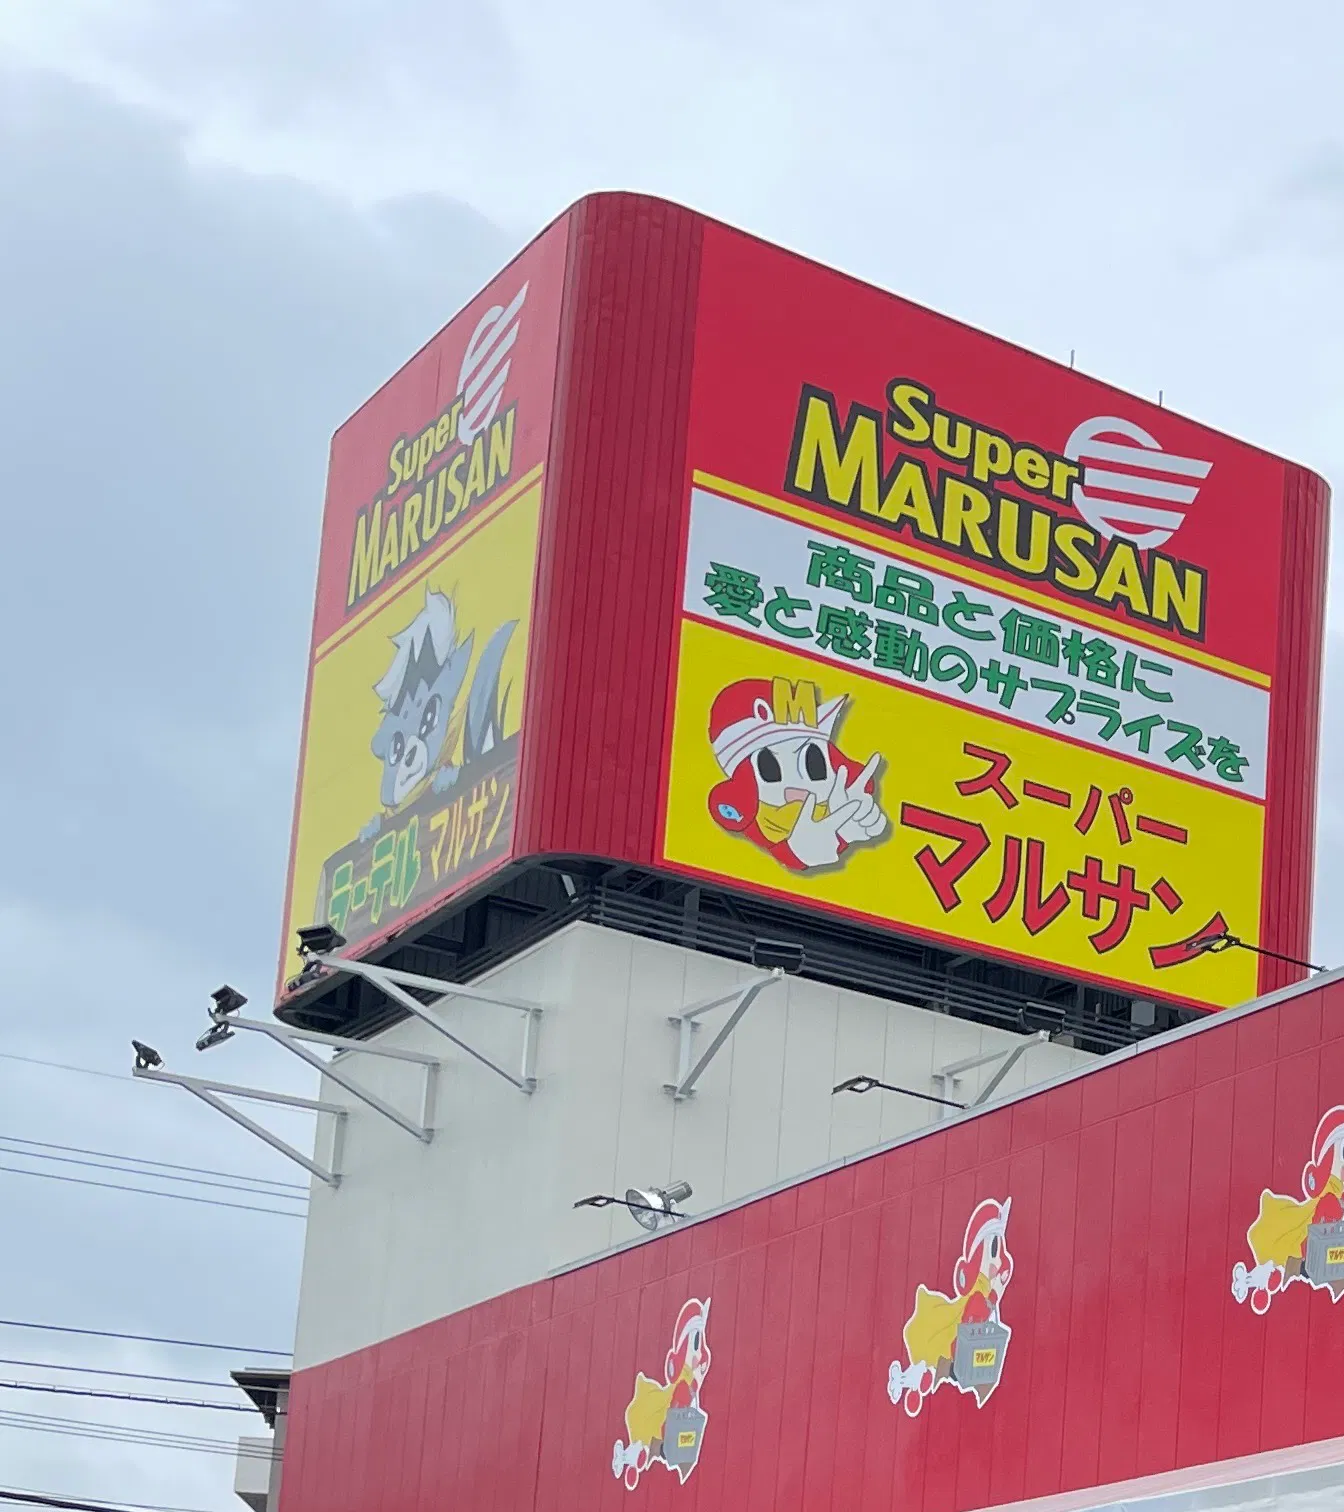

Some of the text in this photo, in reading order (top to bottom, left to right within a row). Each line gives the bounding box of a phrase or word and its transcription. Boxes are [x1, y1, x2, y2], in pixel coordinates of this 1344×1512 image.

[347, 406, 515, 608] MARUSAN
[388, 397, 463, 495] Super
[793, 394, 1204, 637] MARUSAN
[890, 380, 1081, 500] Super
[702, 560, 1249, 784] 愛と感動のサプライズを
[806, 539, 1174, 704] 商品と価格に
[326, 781, 511, 934] ラーテル マルサン
[952, 740, 1190, 847] スーパー
[899, 799, 1229, 970] マルサン
